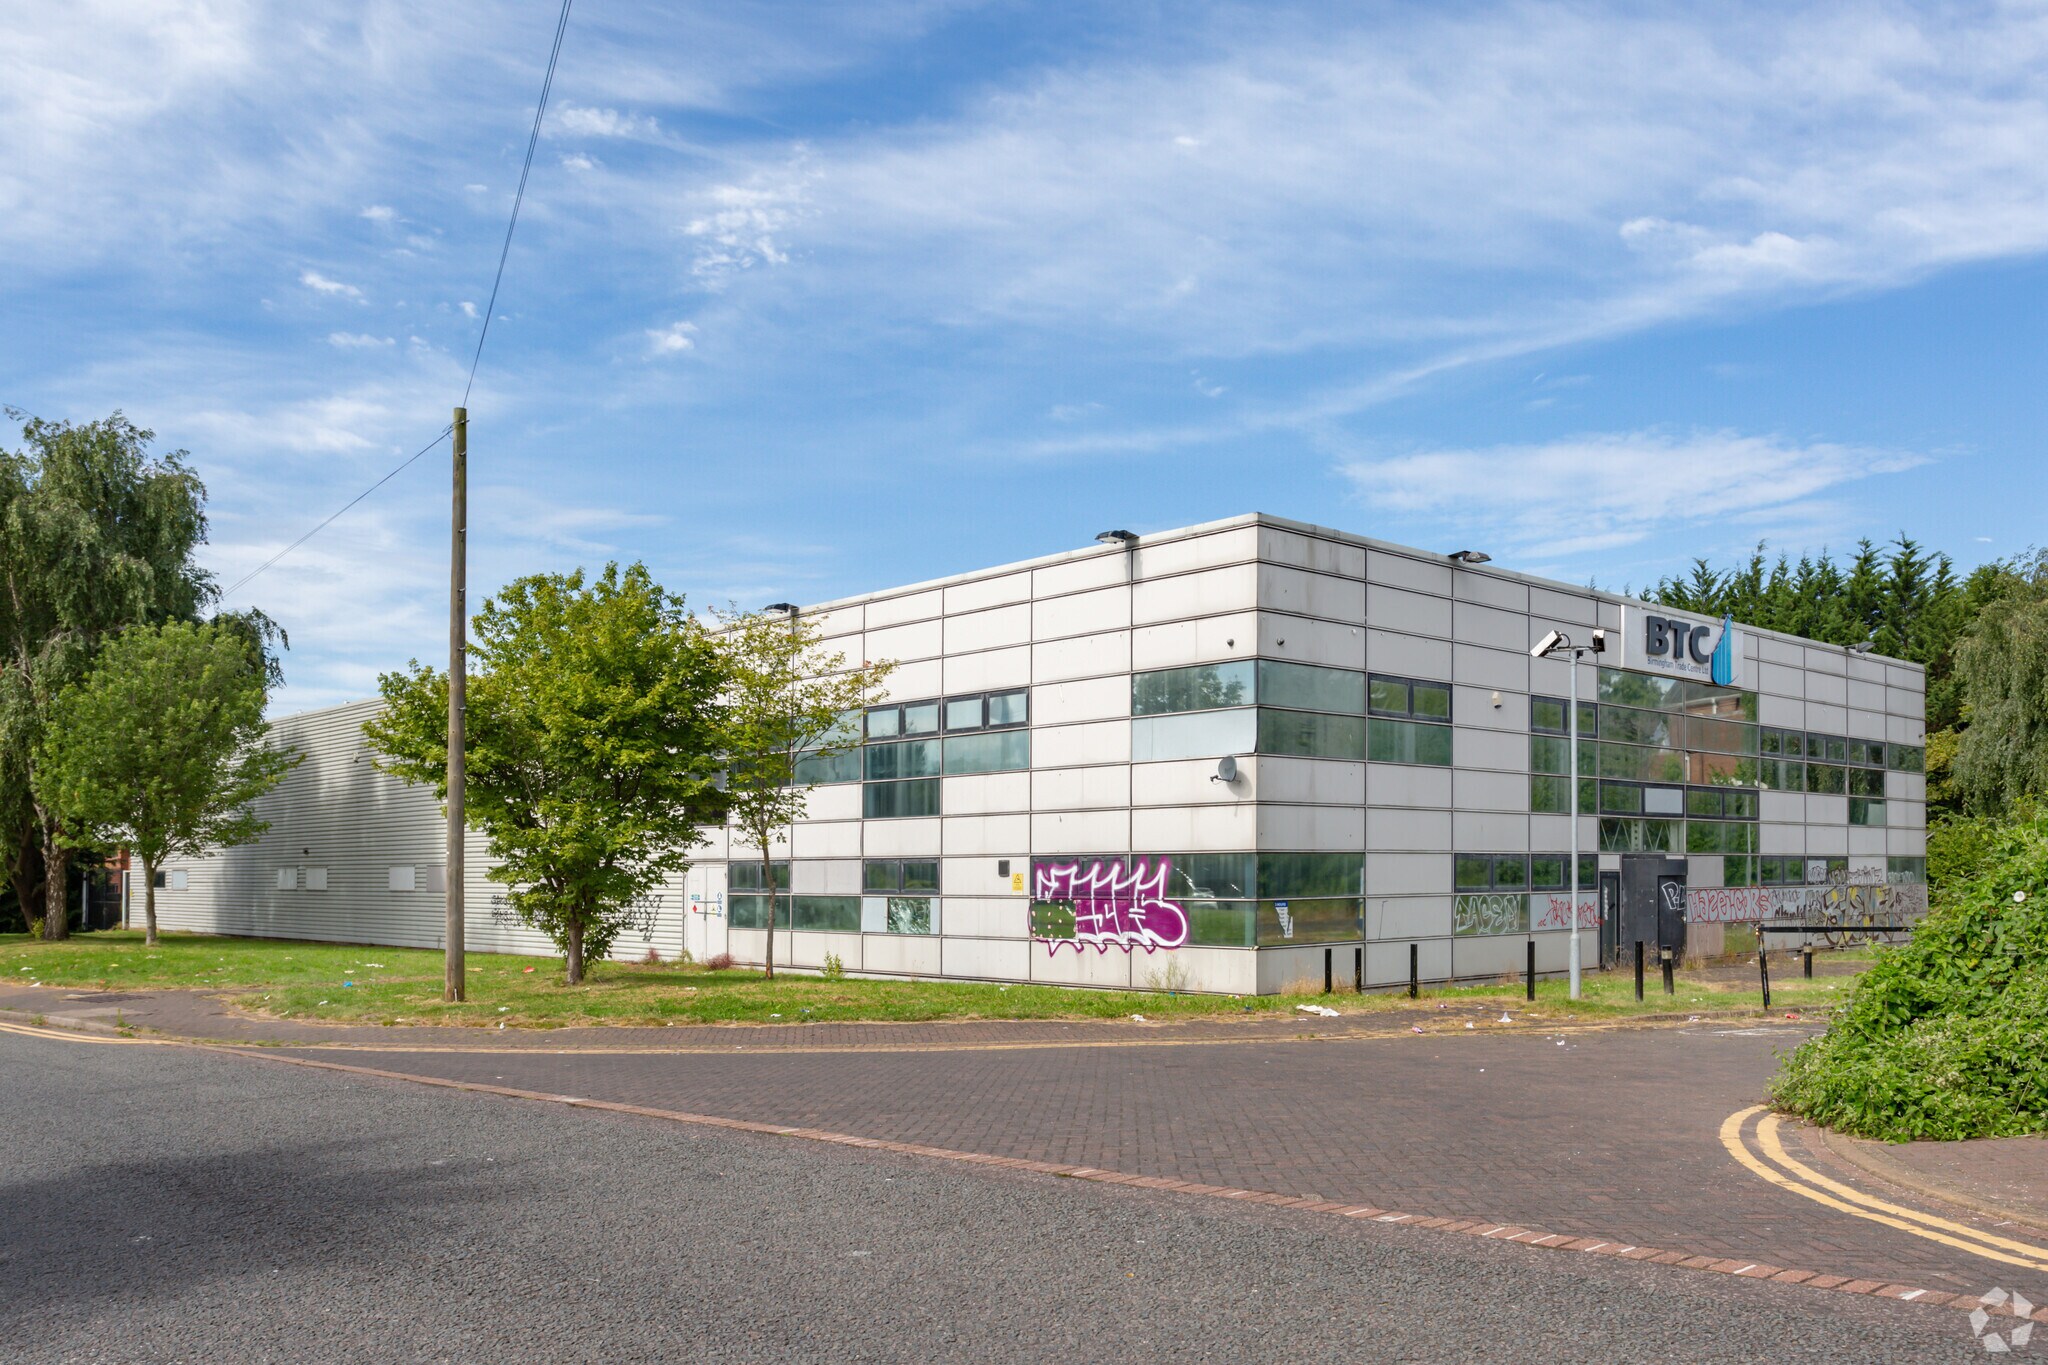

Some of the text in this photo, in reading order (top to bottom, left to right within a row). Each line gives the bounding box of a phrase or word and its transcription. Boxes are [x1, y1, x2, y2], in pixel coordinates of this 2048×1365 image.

[1647, 615, 1710, 664] BTC
[1647, 656, 1673, 669] Birmingham
[1674, 660, 1687, 671] Trade
[1687, 663, 1701, 674] Centre
